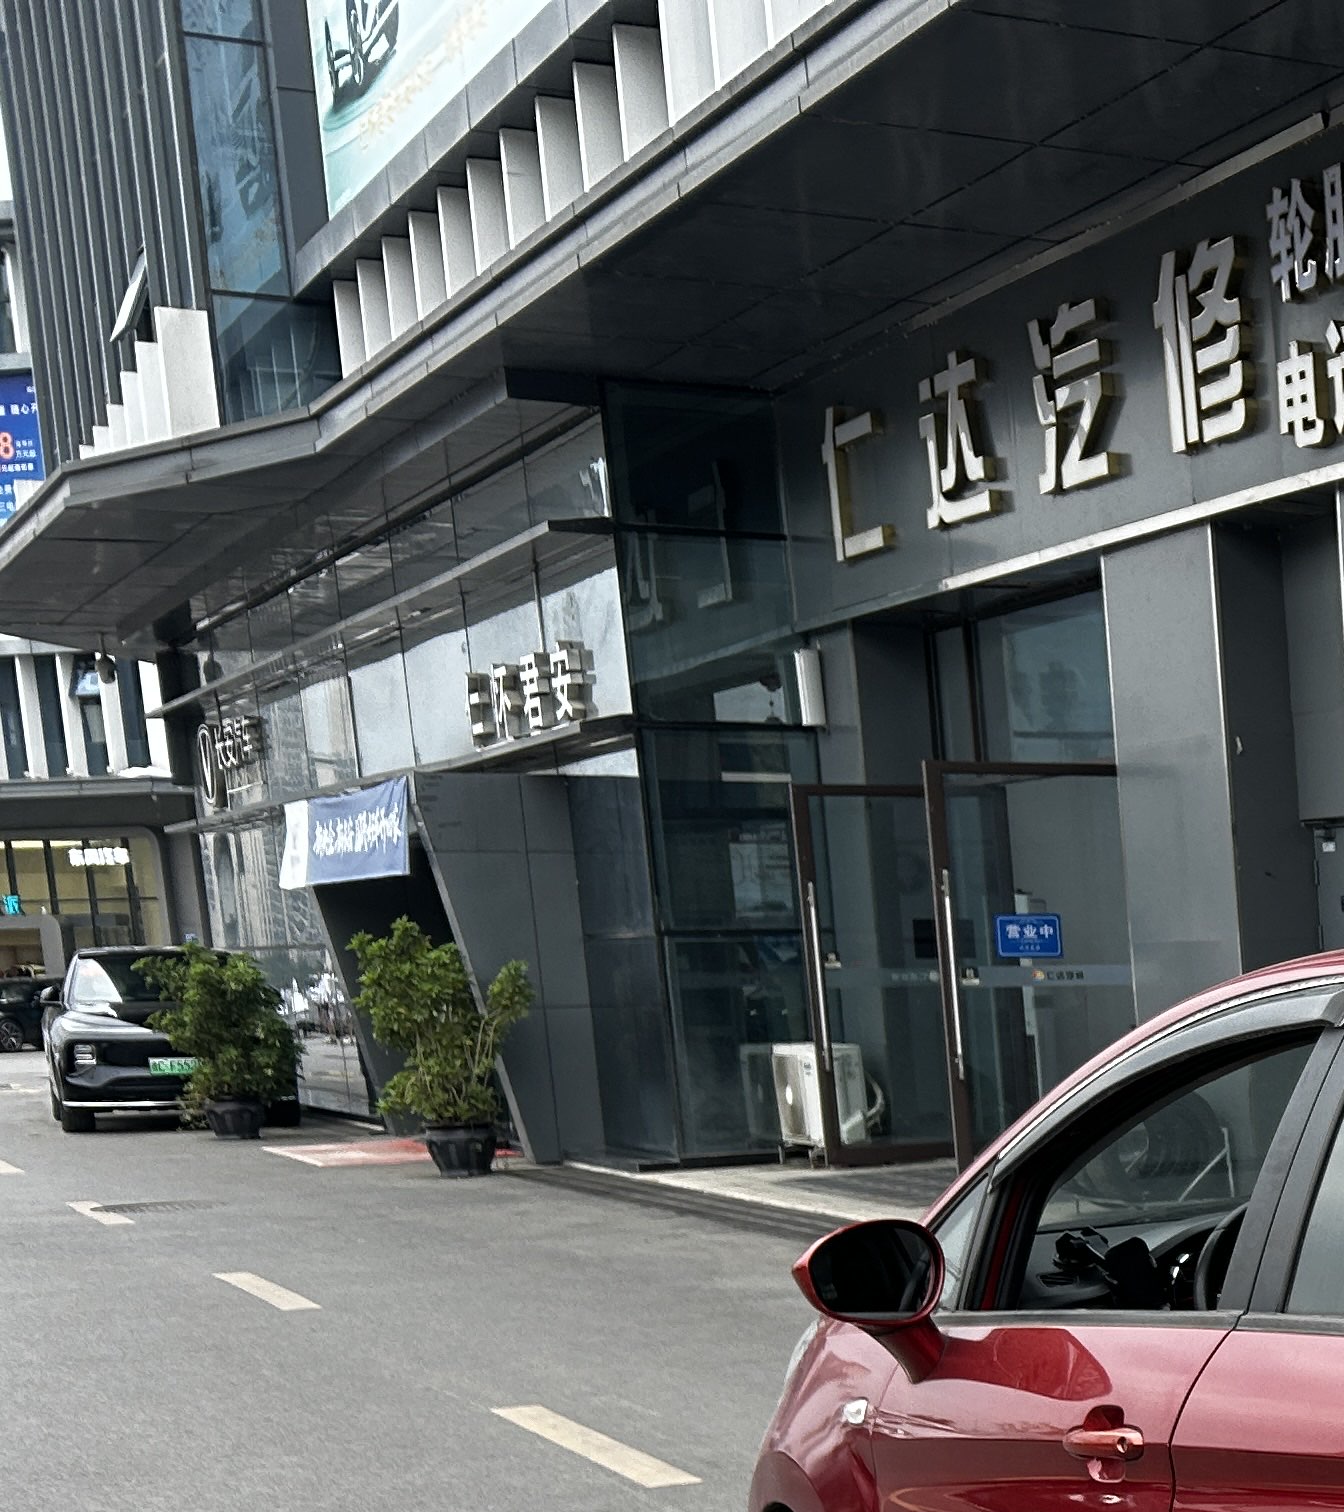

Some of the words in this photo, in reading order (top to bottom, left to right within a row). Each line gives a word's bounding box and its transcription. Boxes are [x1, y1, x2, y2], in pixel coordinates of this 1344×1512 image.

[822, 236, 1252, 562] 仁达汽修
[466, 641, 592, 751] 仁怀君安
[1006, 924, 1054, 939] 营业中
